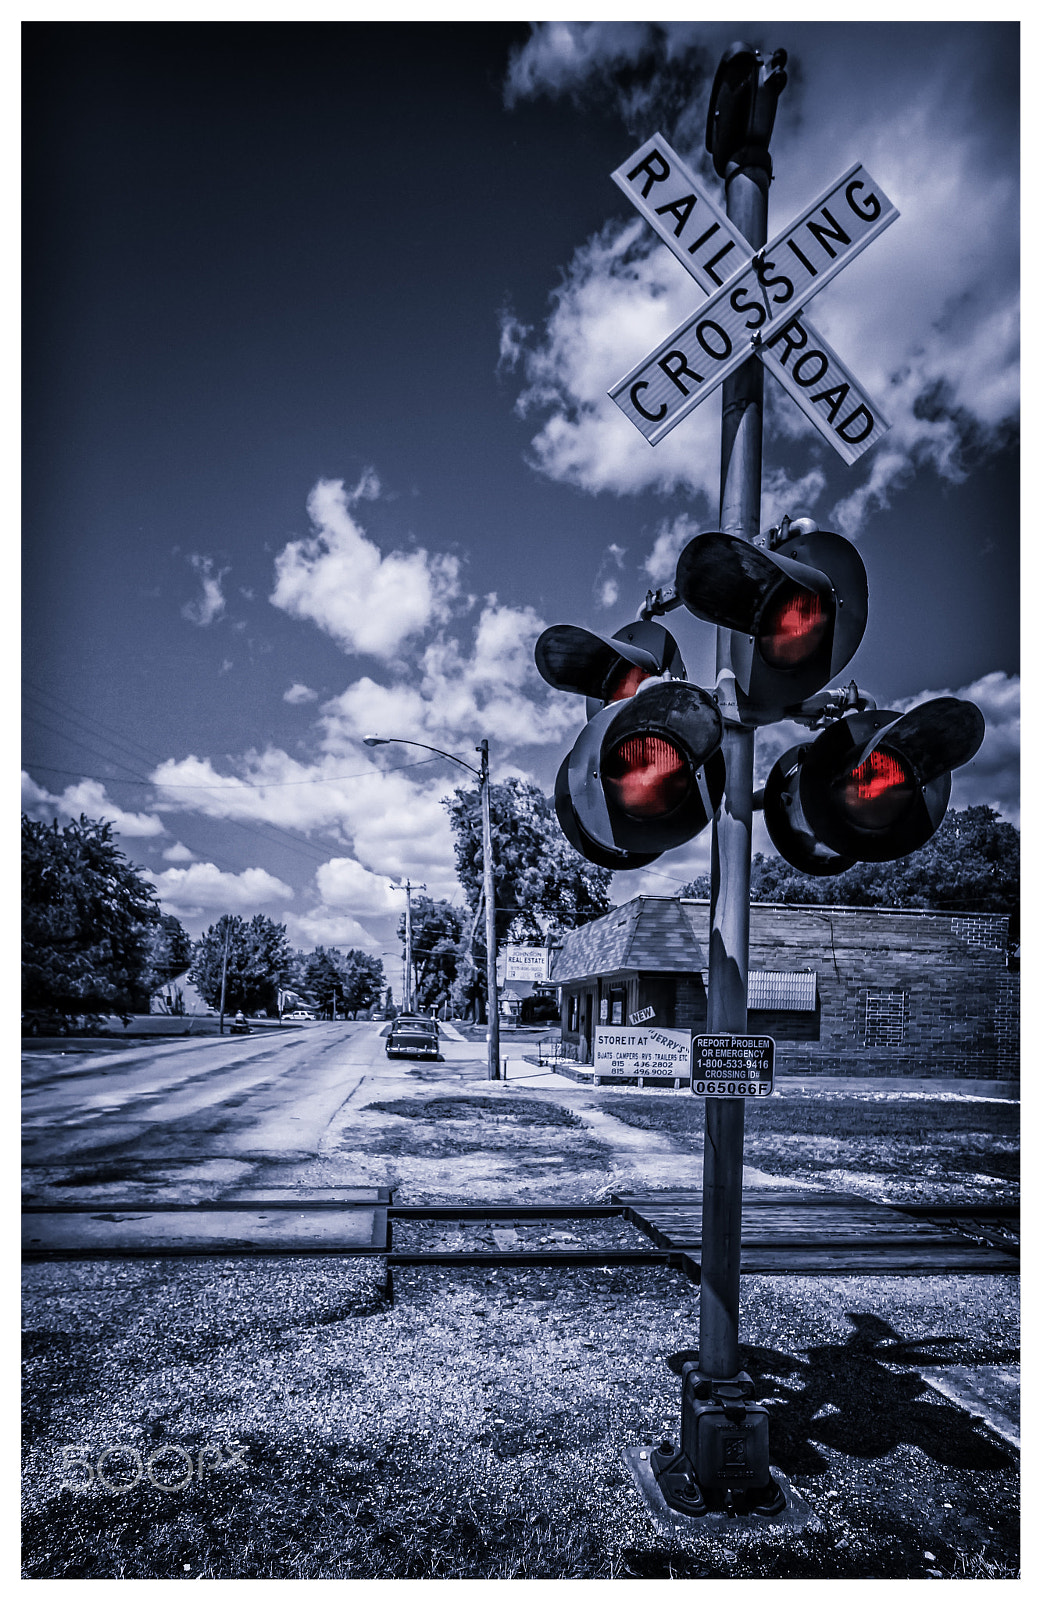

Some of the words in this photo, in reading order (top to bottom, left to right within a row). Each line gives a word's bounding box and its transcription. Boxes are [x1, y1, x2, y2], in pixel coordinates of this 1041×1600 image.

[626, 148, 736, 288] RAIL
[629, 179, 882, 423] CROSSING
[765, 317, 875, 445] ROAD
[631, 1006, 652, 1024] NEW
[598, 1035, 627, 1045] STORE
[628, 1036, 636, 1045] IT
[637, 1037, 648, 1046] AT
[697, 1039, 730, 1048] REPORT
[731, 1039, 770, 1049] PROBLEM
[615, 1052, 639, 1060] CAMPERS
[654, 1053, 677, 1061] TRAILERS
[679, 1054, 688, 1062] ETC
[701, 1048, 714, 1057] OR
[715, 1049, 765, 1058] EMERGENCY
[697, 1058, 769, 1069] 1-800-533-9416
[705, 1070, 746, 1079] CROSSING
[696, 1081, 769, 1095] 065066F
